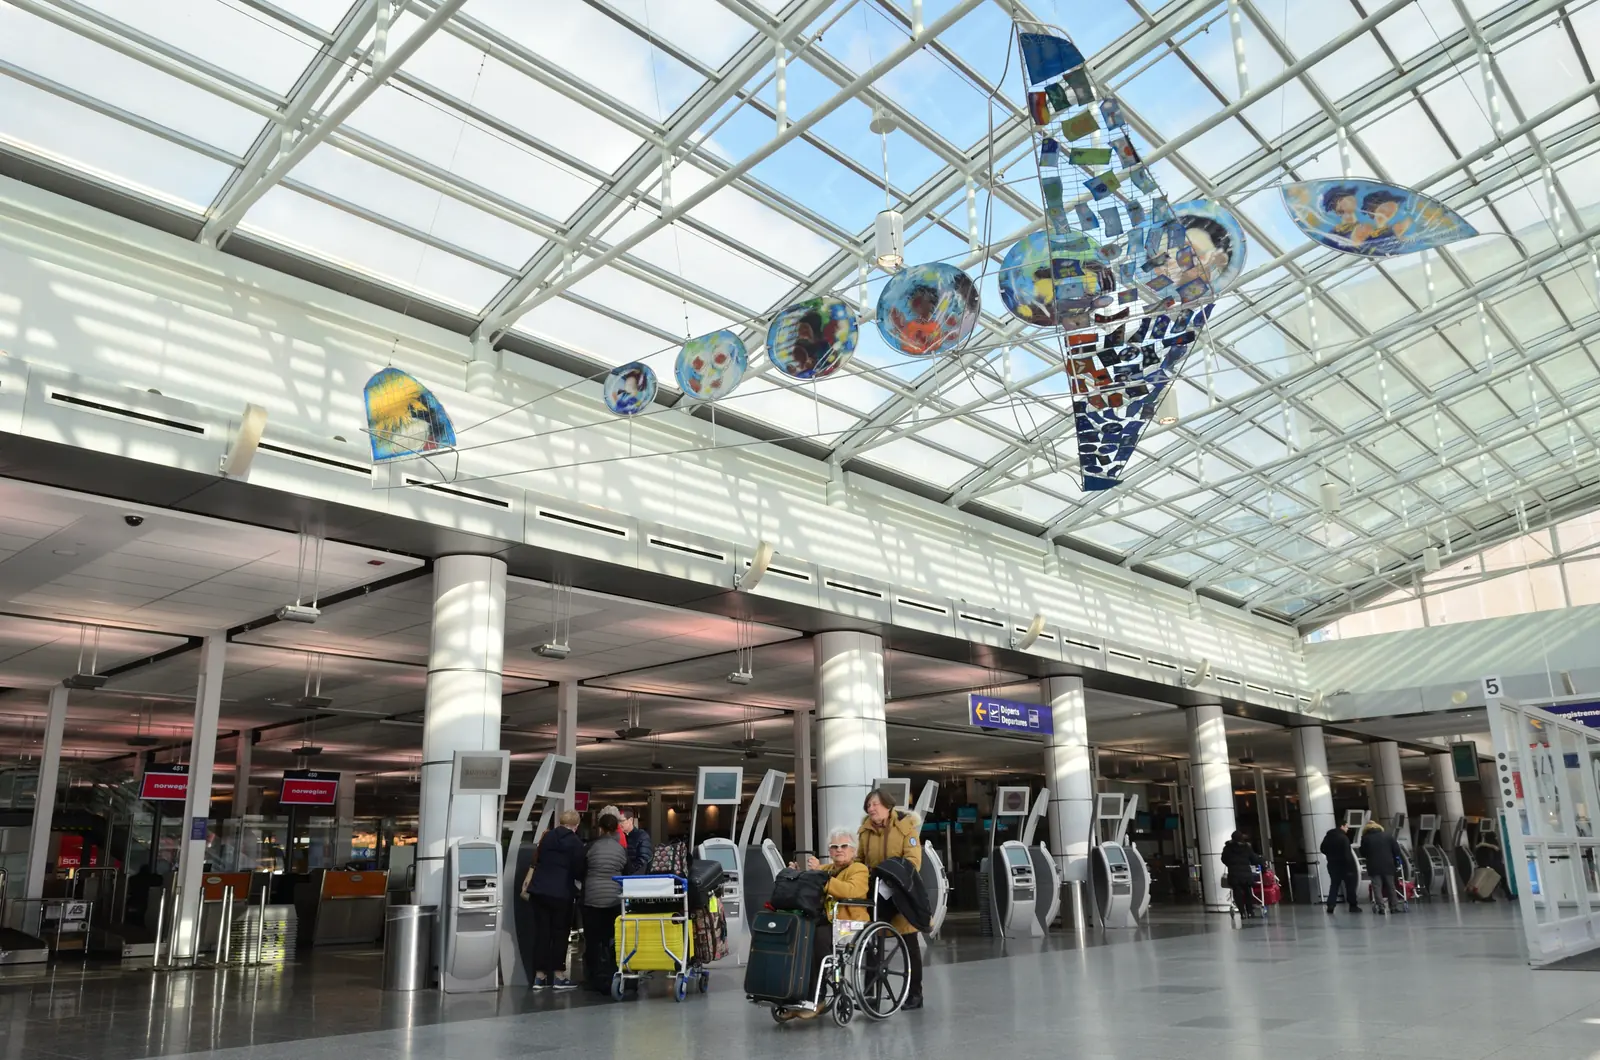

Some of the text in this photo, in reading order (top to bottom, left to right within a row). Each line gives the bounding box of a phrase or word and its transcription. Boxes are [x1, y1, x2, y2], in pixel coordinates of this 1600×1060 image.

[1485, 678, 1499, 695] 5
[1000, 705, 1020, 715] Départs
[1001, 716, 1027, 726] Departures
